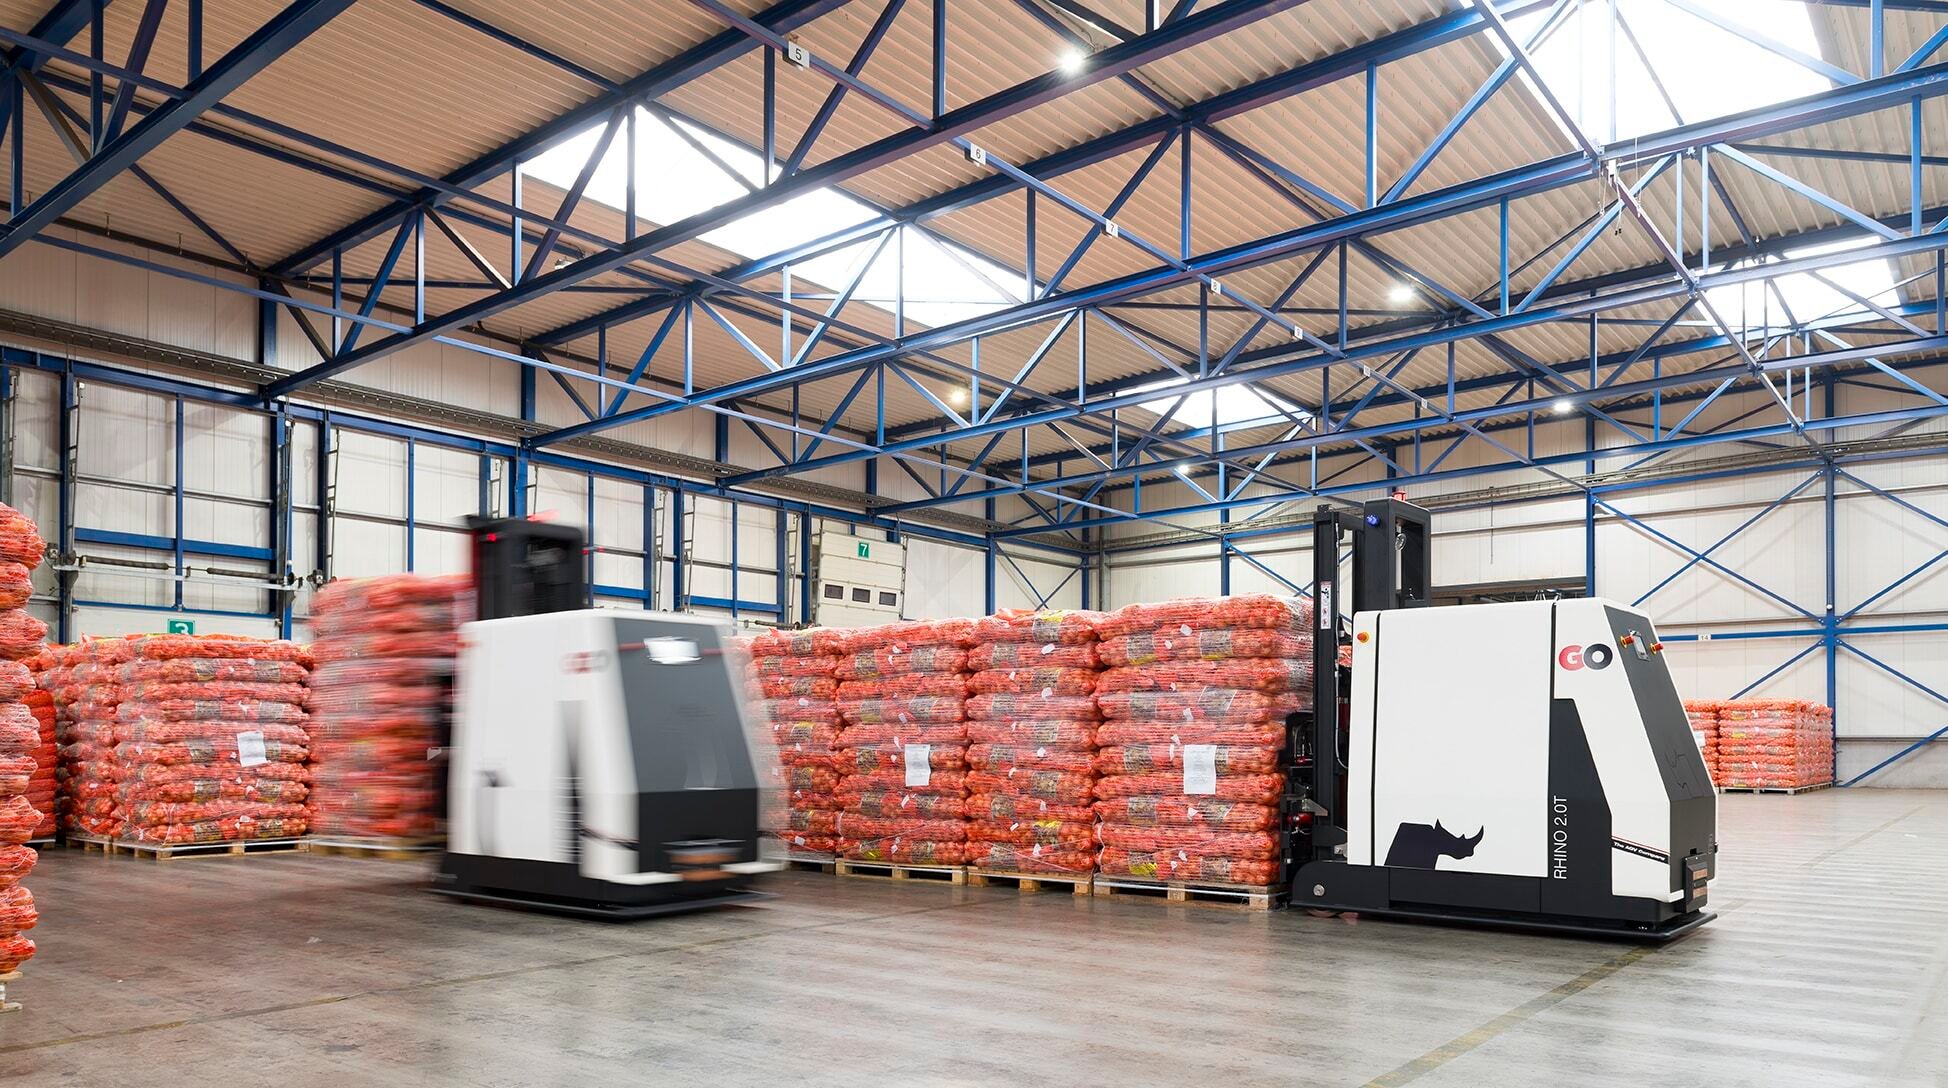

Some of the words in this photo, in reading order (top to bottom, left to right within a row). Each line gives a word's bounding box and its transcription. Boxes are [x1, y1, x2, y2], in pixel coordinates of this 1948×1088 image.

[795, 47, 802, 61] 5
[975, 148, 982, 159] 6
[1110, 223, 1115, 232] 7
[860, 543, 868, 557] 7
[1558, 643, 1613, 671] GO
[1553, 795, 1568, 826] 2.0T
[1553, 830, 1568, 880] RHINO
